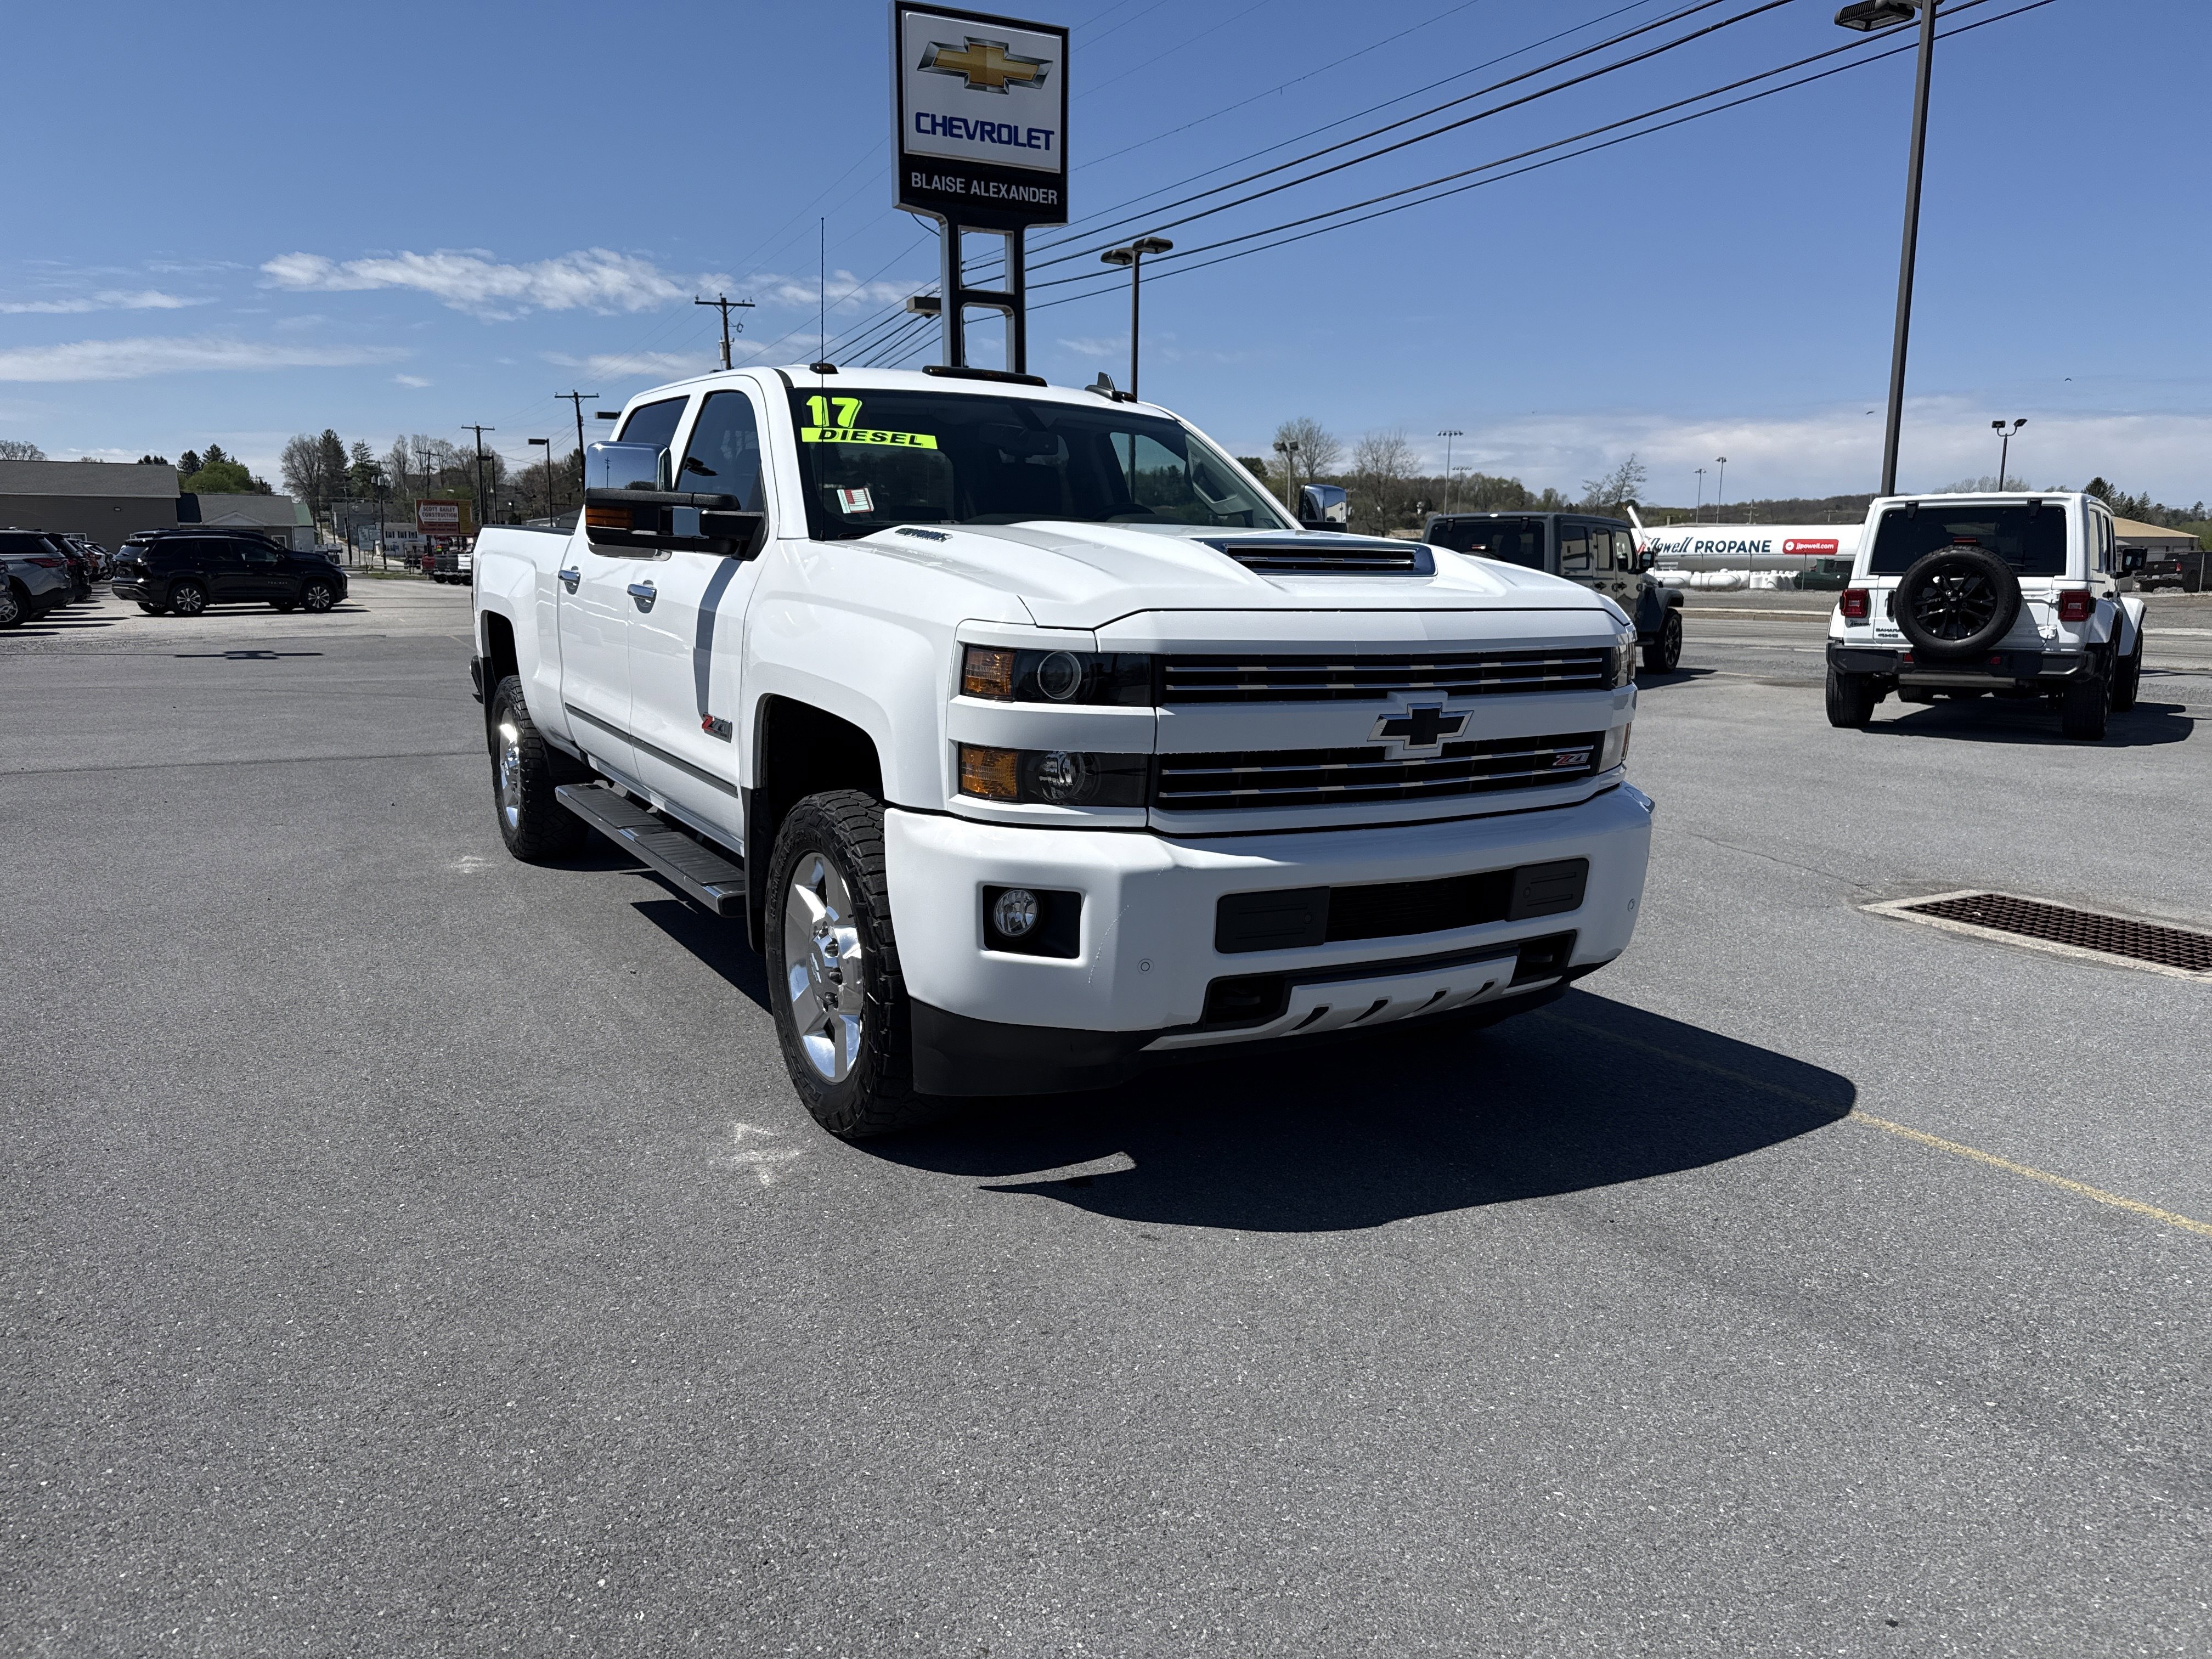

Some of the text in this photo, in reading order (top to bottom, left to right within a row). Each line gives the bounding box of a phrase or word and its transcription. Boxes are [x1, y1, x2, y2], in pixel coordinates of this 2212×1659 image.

[915, 112, 1054, 150] CHEVROLET
[911, 172, 1057, 205] BLAISE ALEXANDER
[806, 395, 862, 428] 17
[818, 429, 923, 446] DIESEL
[1695, 540, 1771, 553] PROPANE
[1552, 753, 1590, 766] Z71
